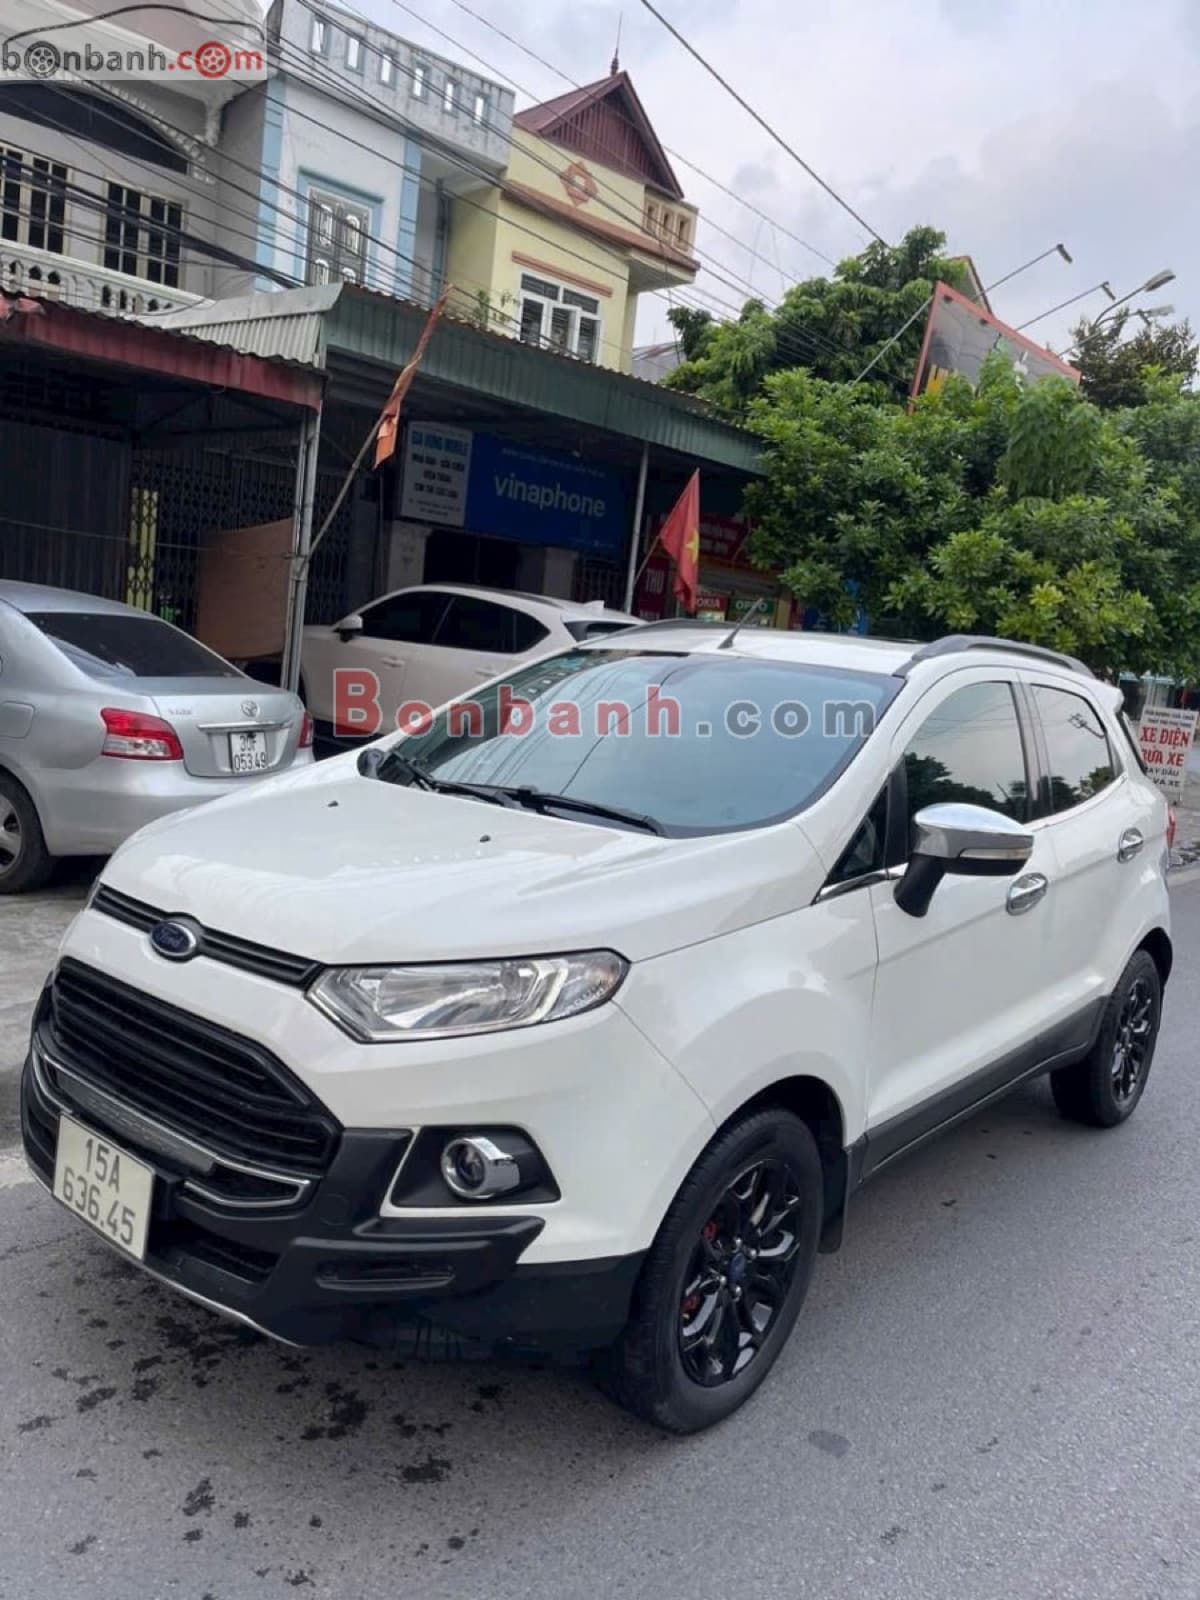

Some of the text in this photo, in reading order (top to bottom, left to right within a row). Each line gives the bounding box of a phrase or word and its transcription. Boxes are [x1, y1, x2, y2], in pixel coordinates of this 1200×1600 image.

[494, 472, 606, 518] vinaphone
[1140, 726, 1158, 743] XE
[1167, 752, 1185, 768] XE
[84, 1138, 121, 1193] 15A
[62, 1166, 136, 1246] 636.45
